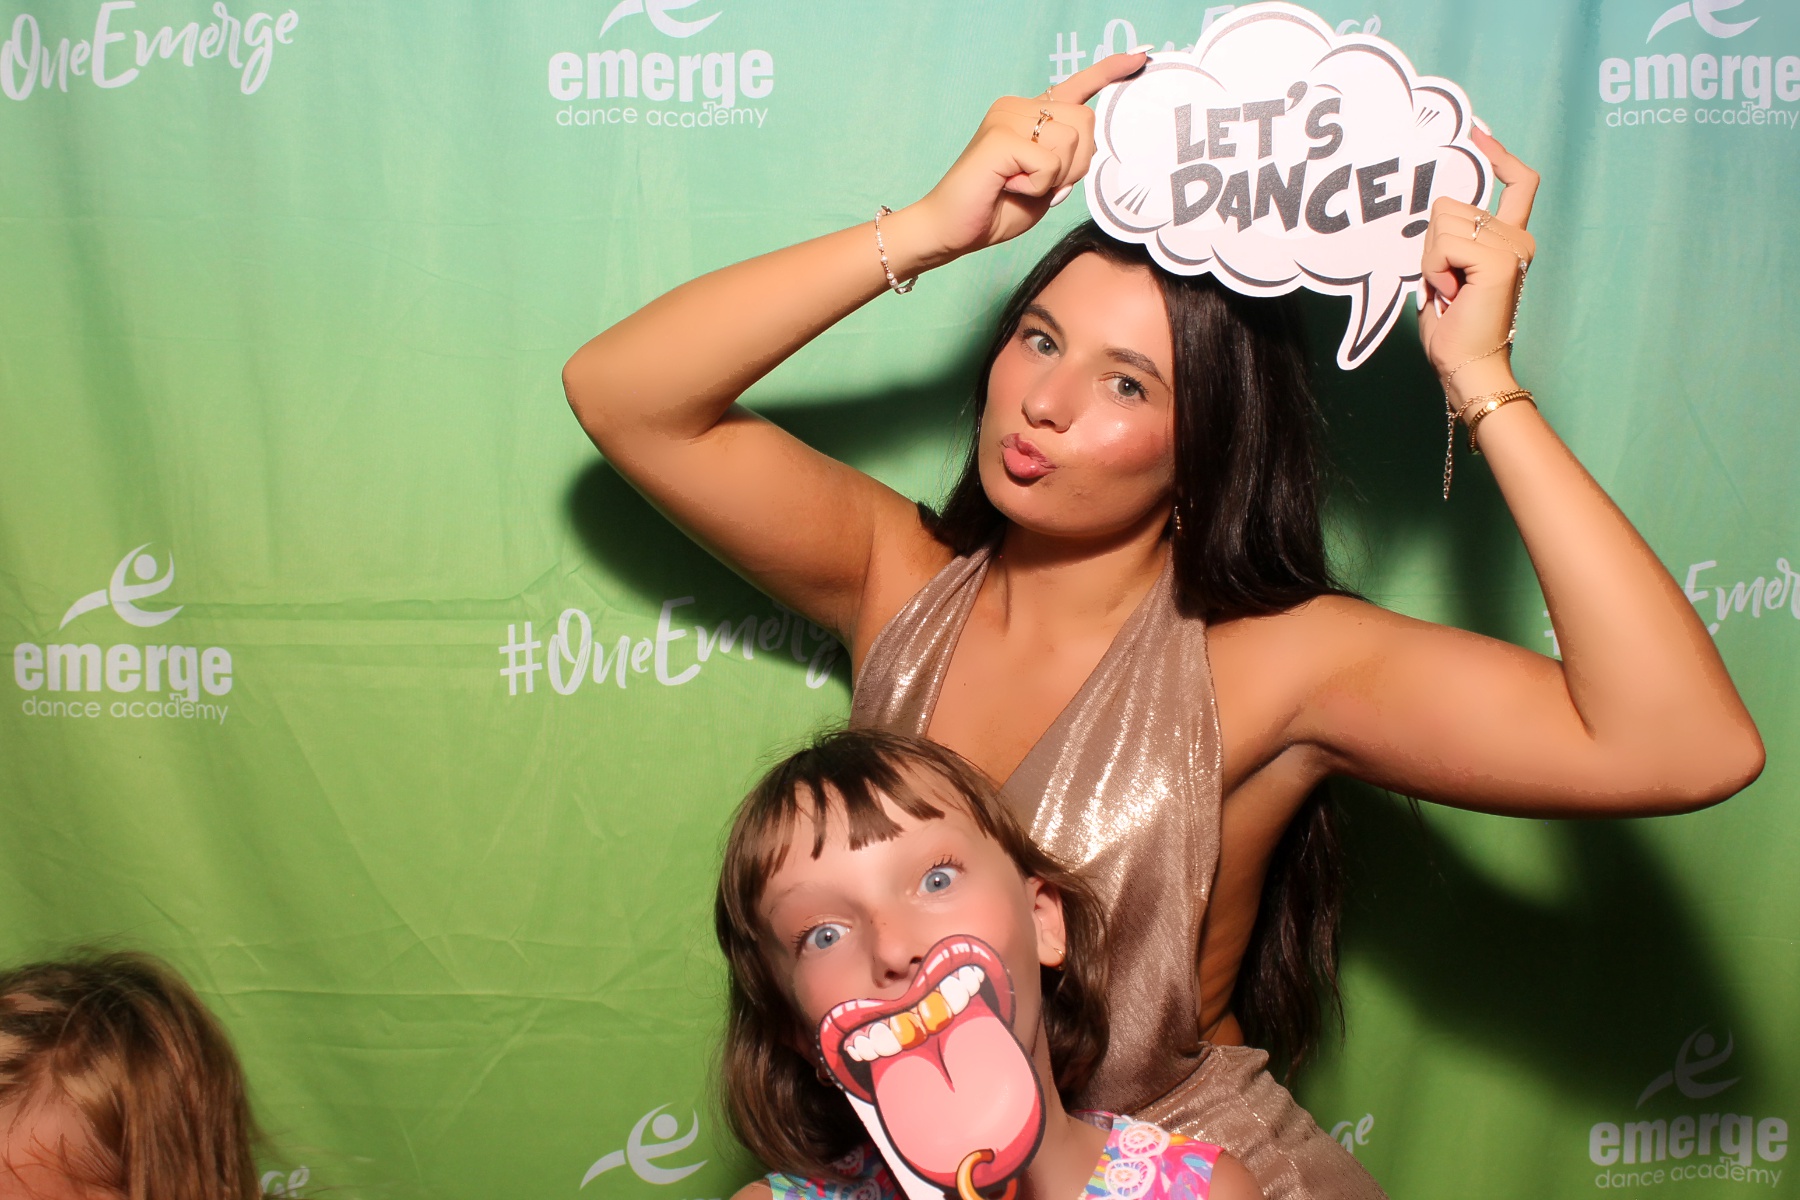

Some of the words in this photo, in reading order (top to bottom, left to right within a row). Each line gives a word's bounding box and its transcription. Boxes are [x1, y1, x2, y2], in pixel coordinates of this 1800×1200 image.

[548, 48, 774, 110] emerge
[1598, 53, 1800, 110] emerge
[556, 105, 638, 126] dance
[646, 103, 768, 129] academy
[1174, 81, 1344, 165] LET'S
[1606, 107, 1687, 127] dance
[1694, 105, 1800, 130] academy
[1170, 156, 1437, 239] DANCE!
[13, 642, 233, 702] emerge
[498, 596, 842, 696] #OneEmerg
[22, 695, 101, 718] dance
[110, 694, 229, 725] academy
[1589, 1112, 1788, 1167] emerge
[1595, 1169, 1665, 1188] dance
[1670, 1160, 1783, 1188] academy
